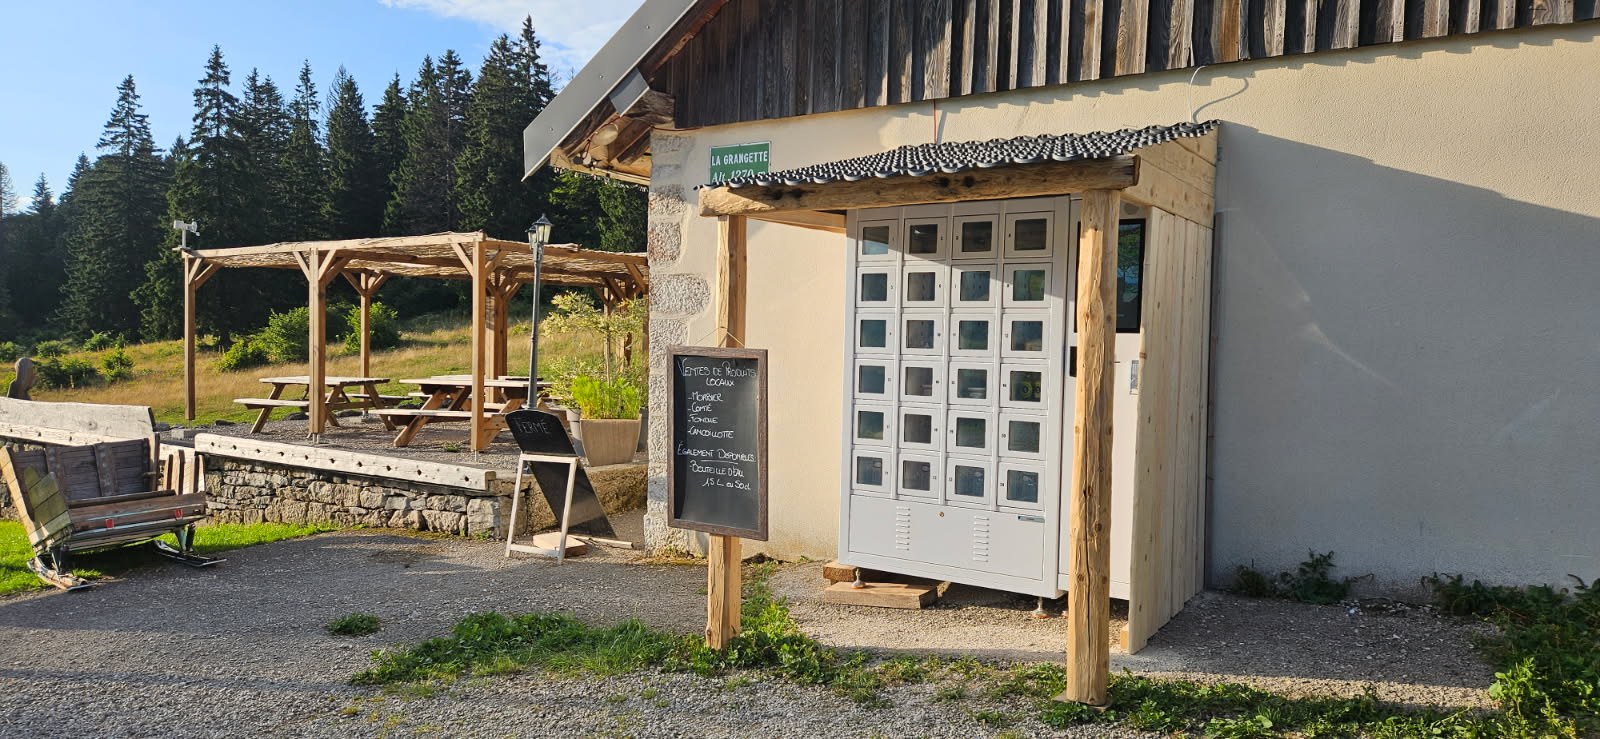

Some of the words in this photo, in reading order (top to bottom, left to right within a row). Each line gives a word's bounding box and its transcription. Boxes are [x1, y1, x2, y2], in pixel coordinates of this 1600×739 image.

[711, 155, 721, 166] LA
[723, 151, 768, 165] GRANGETTE
[705, 377, 735, 387] LOCAUX
